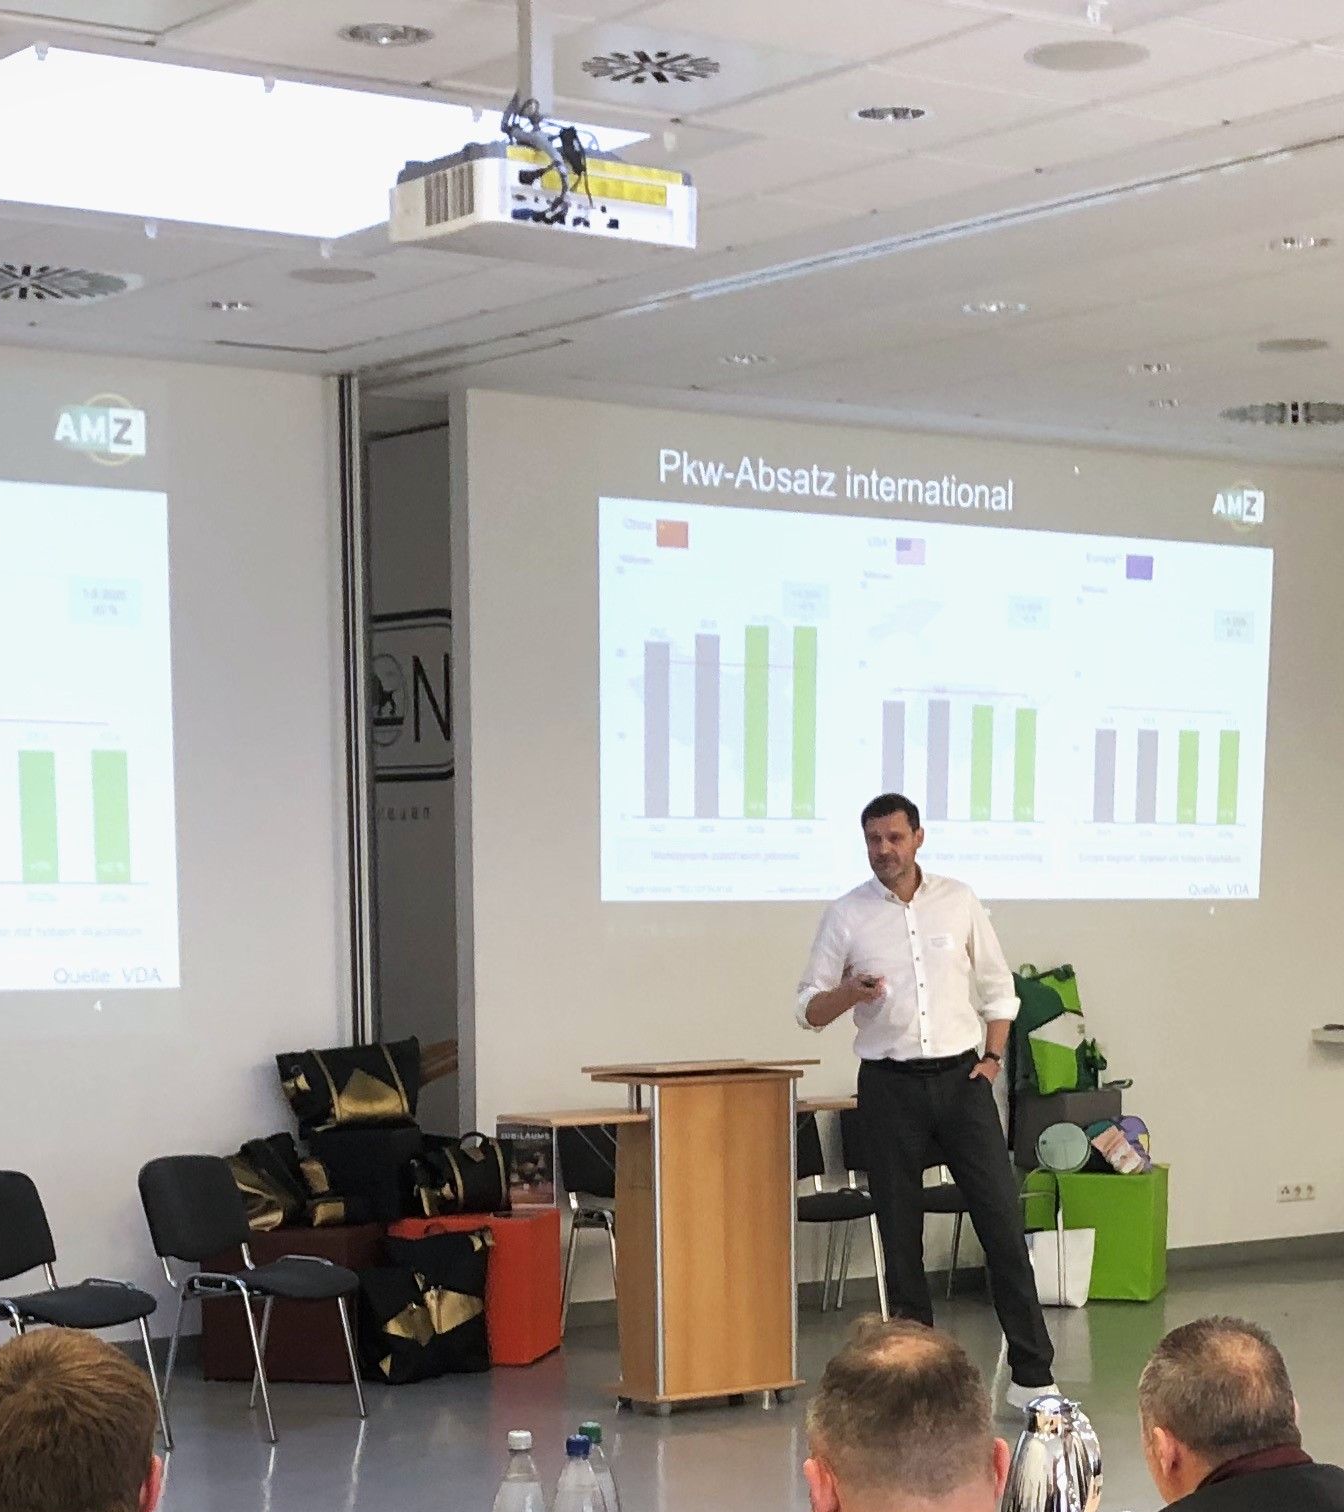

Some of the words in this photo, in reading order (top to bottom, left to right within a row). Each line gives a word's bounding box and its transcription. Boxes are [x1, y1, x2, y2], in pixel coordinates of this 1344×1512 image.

[54, 409, 136, 449] AMZ
[658, 448, 838, 498] Pkw-Absatz
[846, 463, 1014, 513] international
[1211, 491, 1261, 518] AMZ
[121, 966, 163, 984] VDA
